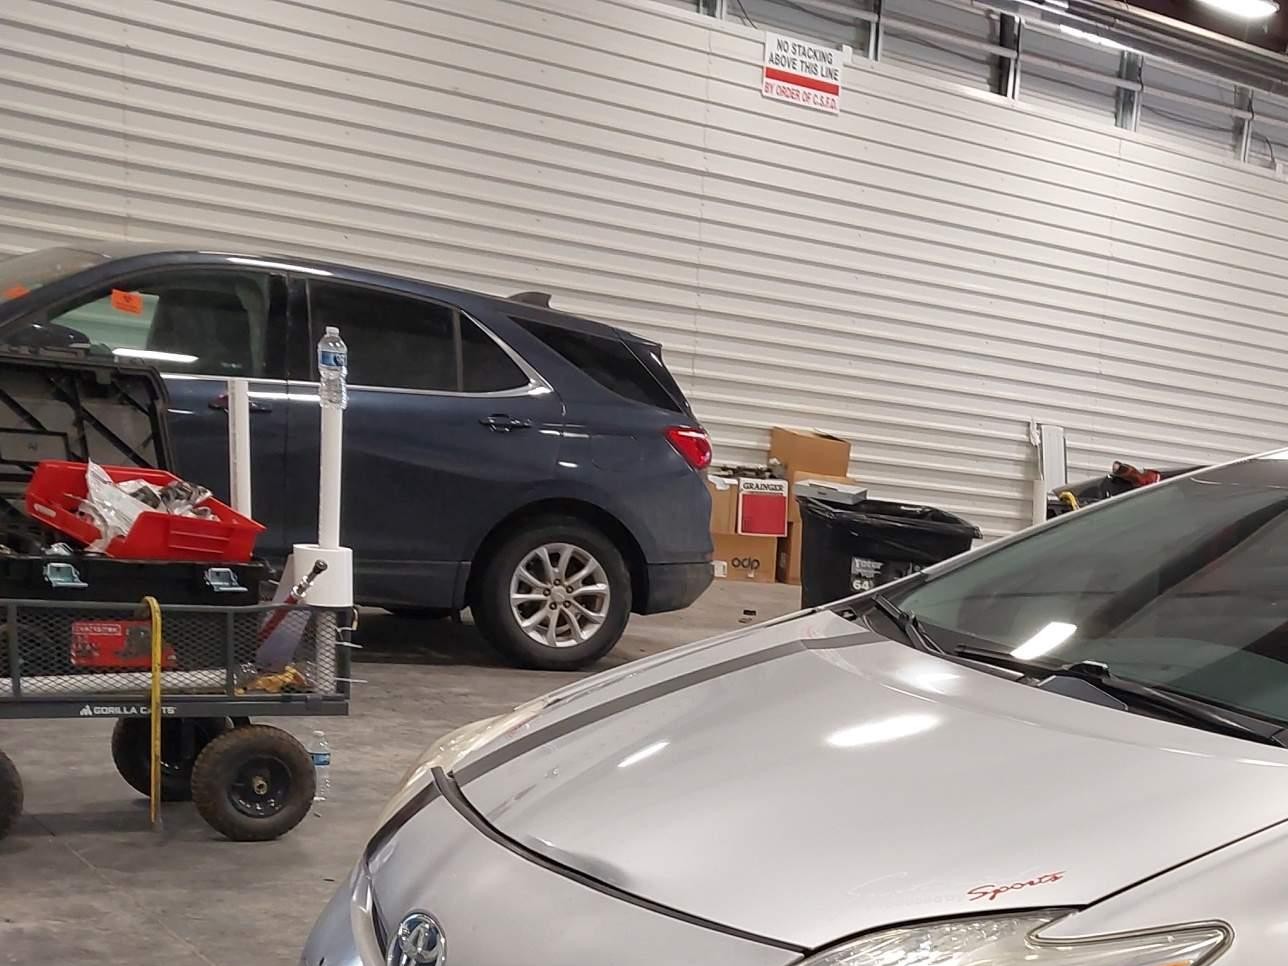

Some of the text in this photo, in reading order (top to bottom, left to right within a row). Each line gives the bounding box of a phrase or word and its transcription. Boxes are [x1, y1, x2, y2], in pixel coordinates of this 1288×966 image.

[776, 38, 833, 65] NO STACKING
[768, 52, 839, 81] ABOVE THIS LINE
[764, 82, 774, 93] BY
[775, 85, 800, 101] ORDER
[802, 91, 812, 103] OF
[743, 482, 784, 491] GRAINGER
[731, 556, 760, 570] odp
[93, 706, 138, 714] GORILLA
[967, 870, 1068, 901] Sports
